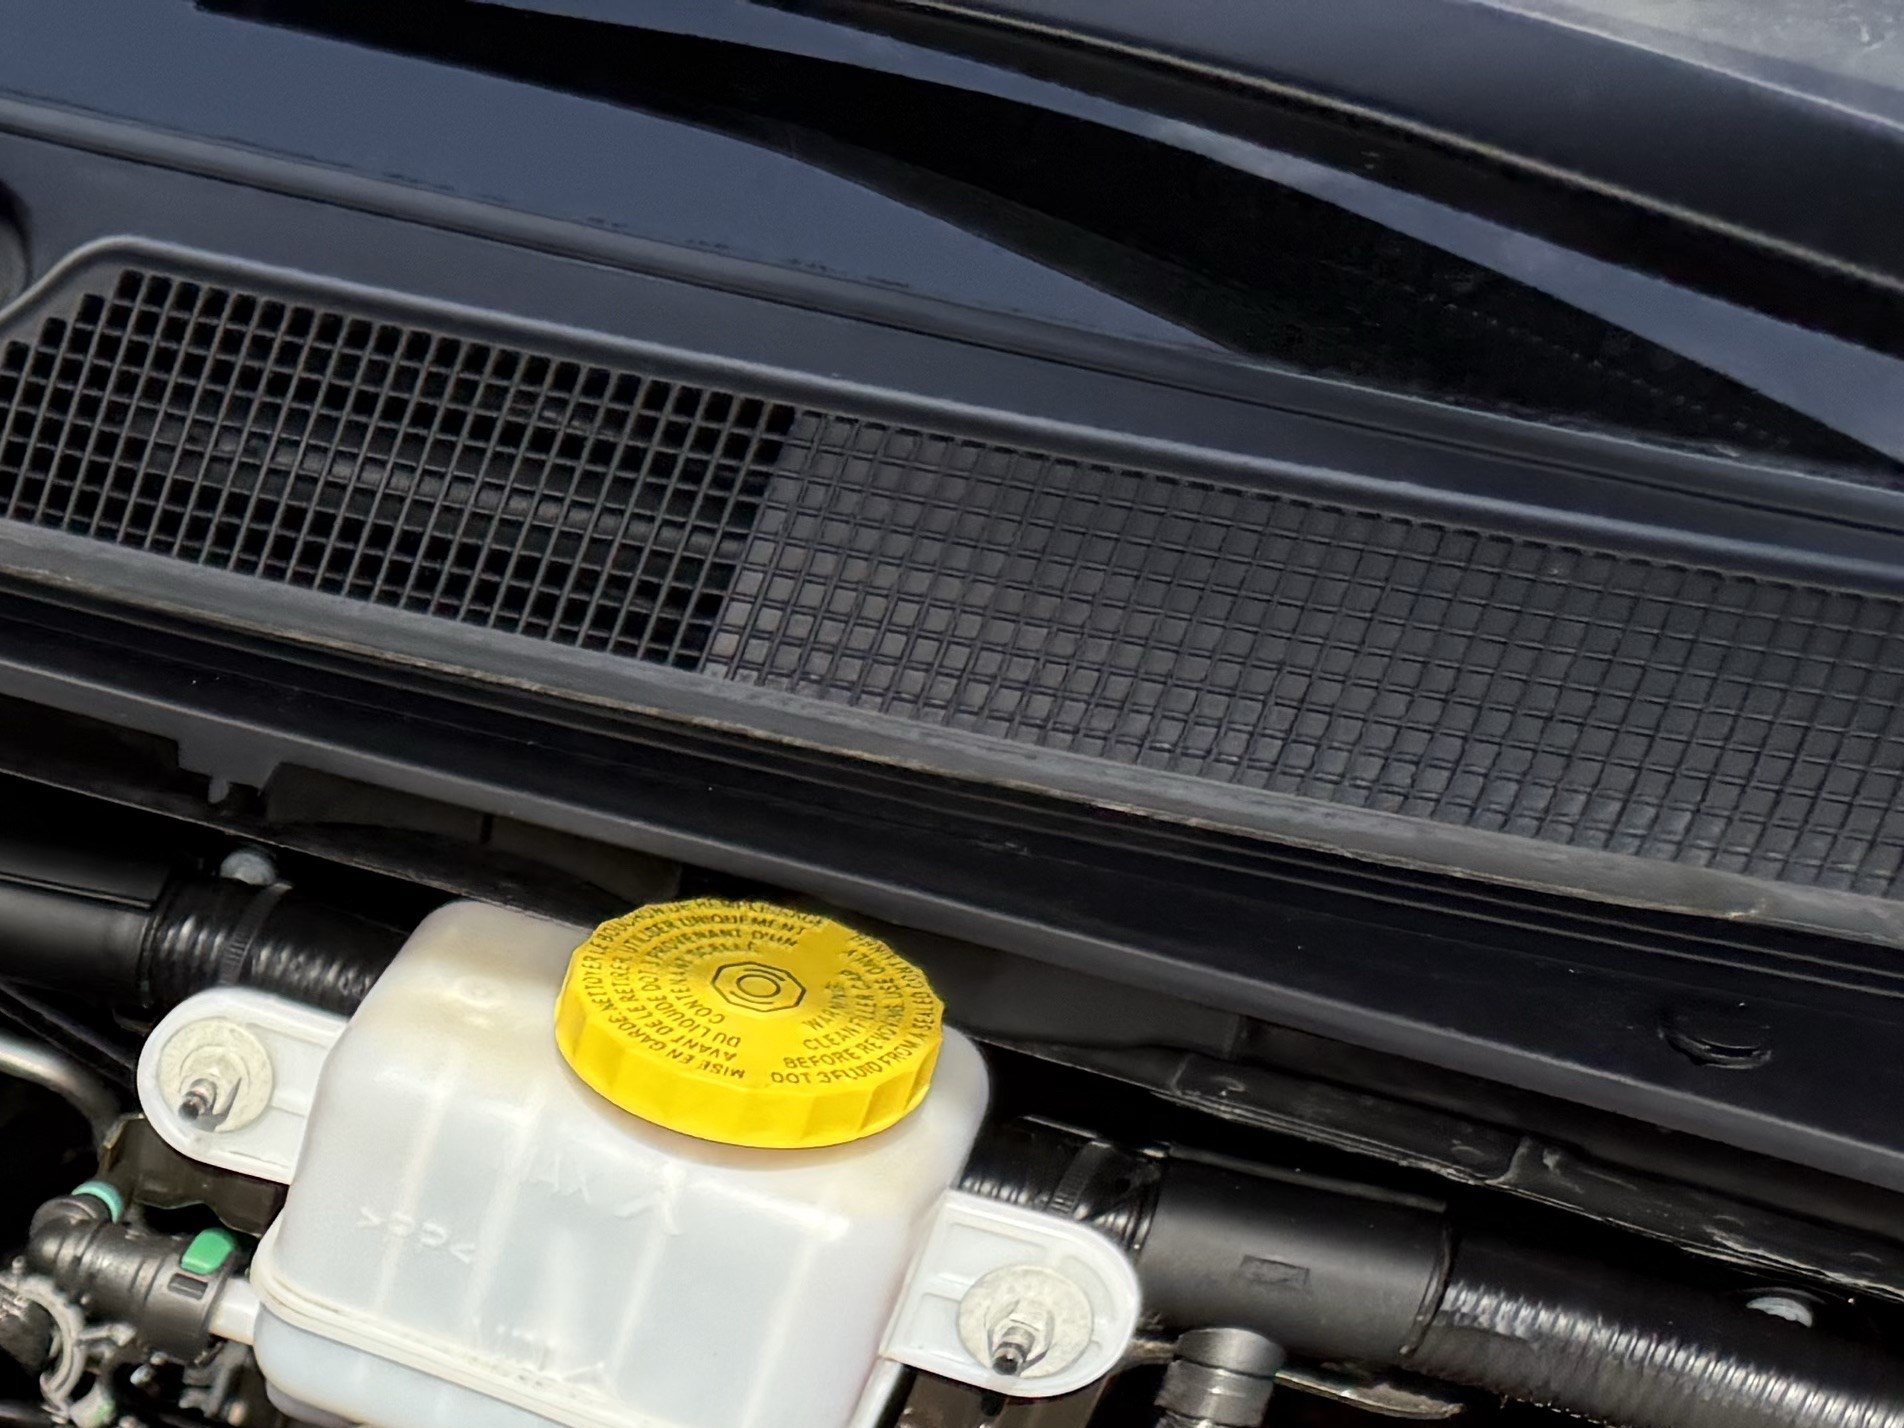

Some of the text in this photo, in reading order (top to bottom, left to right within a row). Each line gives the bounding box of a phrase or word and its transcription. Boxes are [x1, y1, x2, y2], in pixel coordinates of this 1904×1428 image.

[644, 1018, 675, 1036] DE
[647, 993, 711, 1038] LIQUIDE
[711, 1031, 743, 1049] DU
[802, 1019, 861, 1051] CLEAN
[666, 1049, 696, 1066] EN
[670, 1034, 739, 1063] AVANT
[783, 1047, 862, 1070] BEFORE
[697, 1060, 746, 1080] MISE
[770, 1070, 812, 1085] DOT
[818, 1071, 833, 1085] 3
[879, 1036, 921, 1068] FROM
